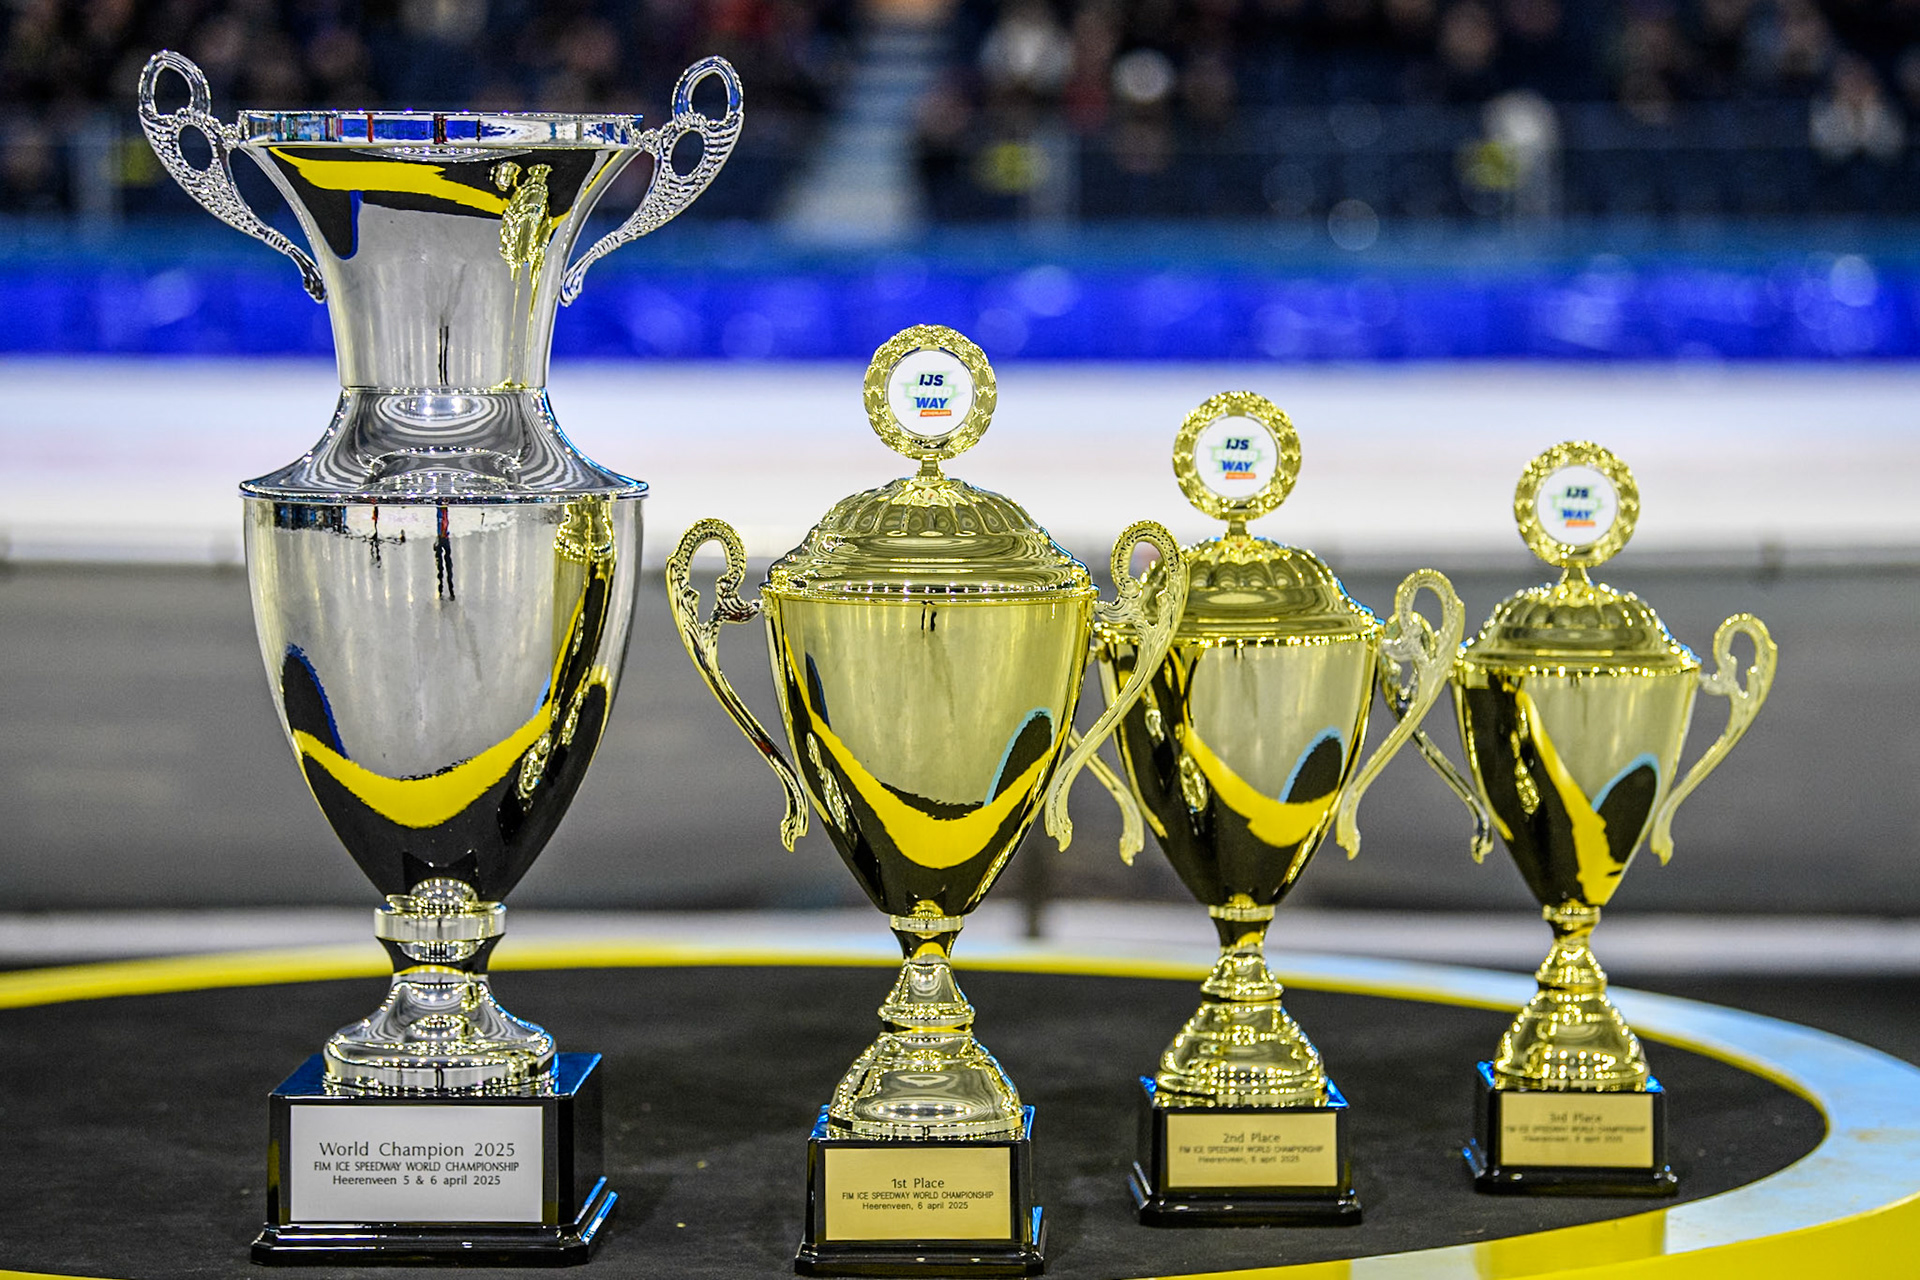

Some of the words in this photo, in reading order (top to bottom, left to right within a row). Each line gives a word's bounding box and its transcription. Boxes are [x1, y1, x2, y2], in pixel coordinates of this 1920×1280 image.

[919, 374, 944, 386] IJS
[913, 397, 949, 408] WAY
[1226, 438, 1250, 450] IJS
[1222, 460, 1253, 472] WAY
[1562, 509, 1593, 519] WAY
[1223, 1132, 1244, 1143] 2nd
[1251, 1132, 1281, 1143] Place
[319, 1141, 369, 1157] World
[379, 1141, 464, 1160] Champion
[474, 1141, 515, 1157] 2025
[314, 1162, 331, 1172] FIM
[336, 1162, 350, 1172] ICE
[354, 1162, 402, 1172] SPEEDWAY
[405, 1162, 441, 1172] WORLD
[445, 1162, 520, 1172] CHAMPIONSHIP
[332, 1175, 396, 1185] Heerenveen
[403, 1175, 410, 1185] 5
[416, 1175, 424, 1185] &
[430, 1175, 437, 1185] 6
[443, 1175, 467, 1187] april
[473, 1175, 501, 1185] 2025
[891, 1178, 907, 1188] 1st
[914, 1178, 945, 1188] Place
[842, 1191, 854, 1200] FIM
[857, 1191, 868, 1200] ICE
[872, 1191, 910, 1200] SPEEDWAY
[913, 1191, 938, 1200] WORLD
[942, 1191, 994, 1200] CHAMPIONSHIP
[862, 1202, 914, 1211] Heerenveen,
[928, 1202, 944, 1211] april
